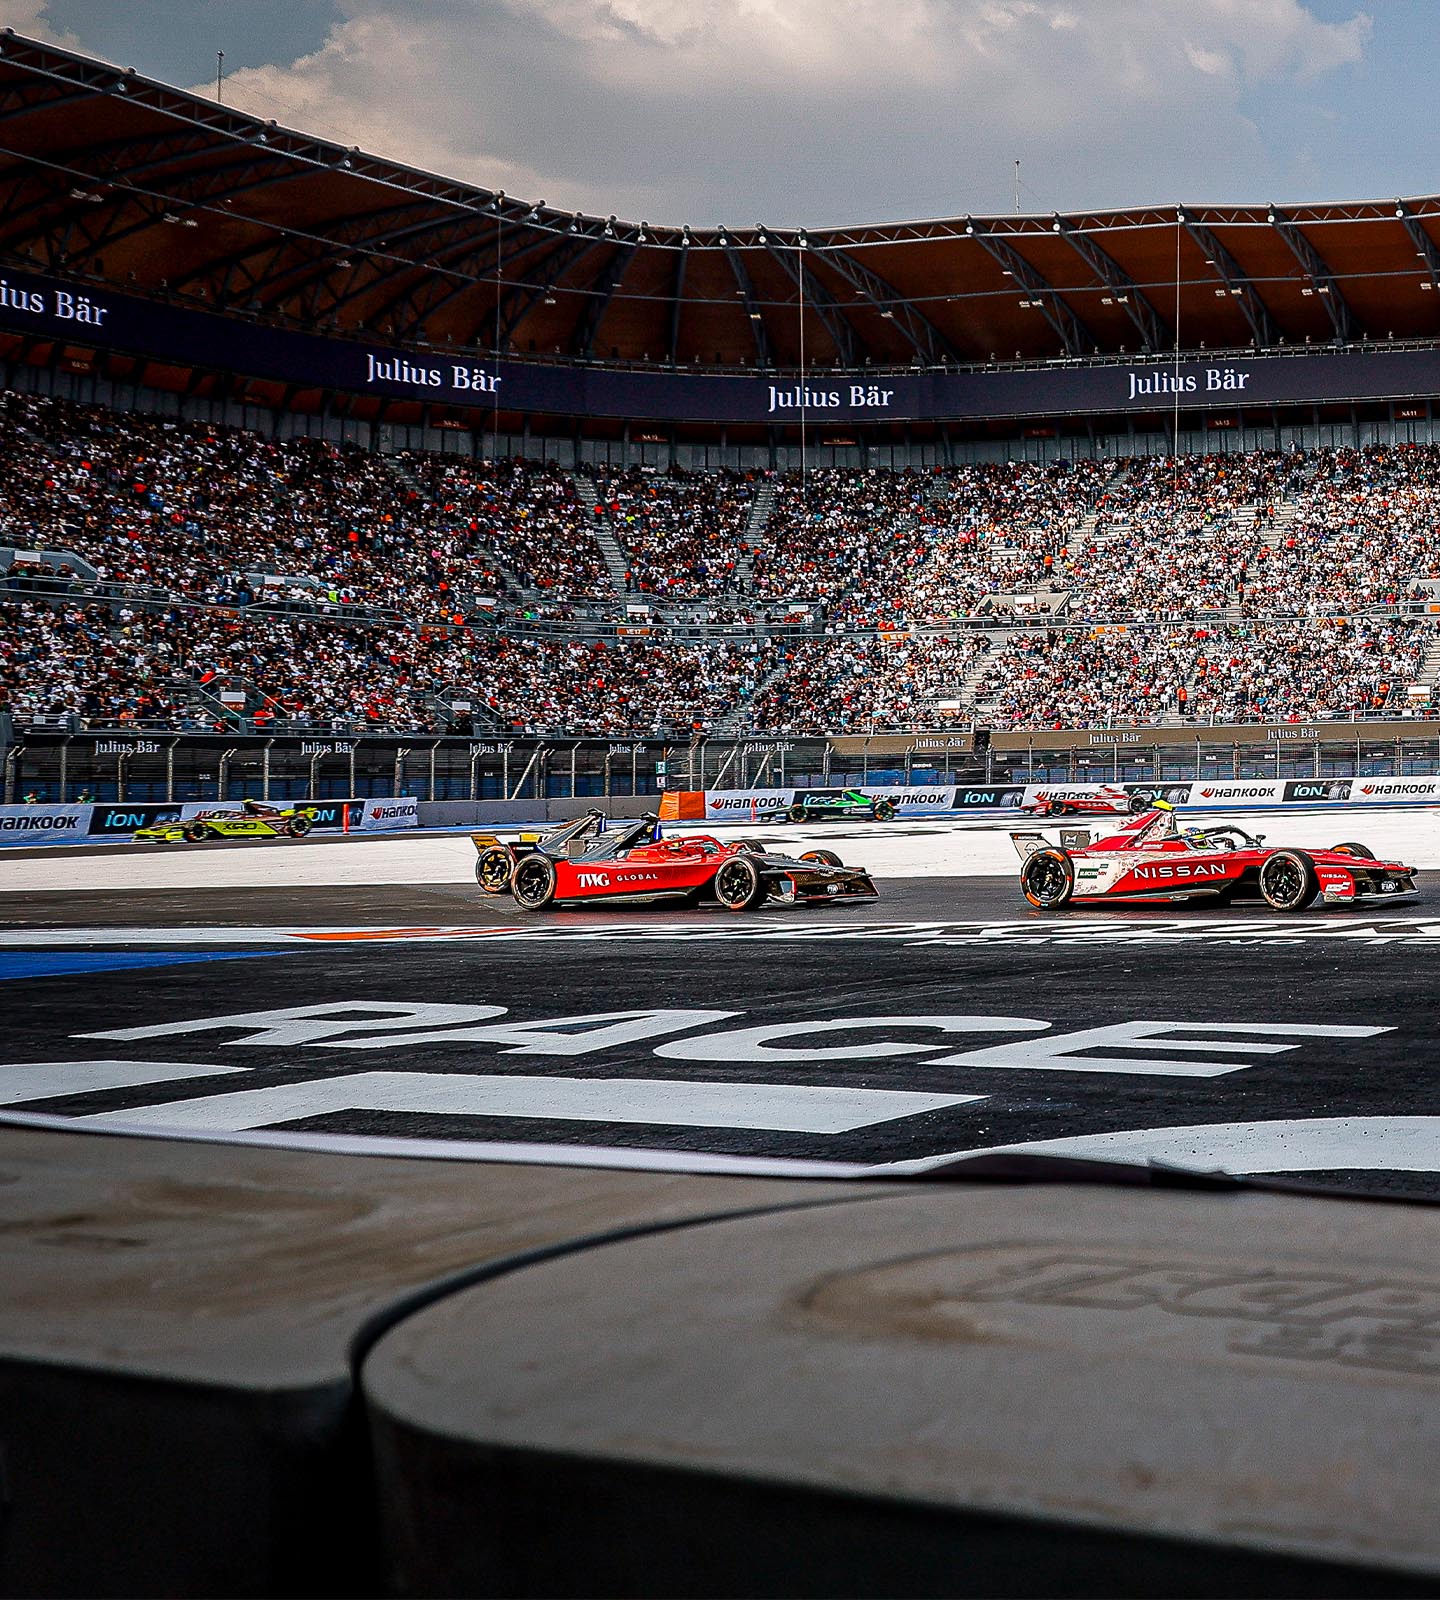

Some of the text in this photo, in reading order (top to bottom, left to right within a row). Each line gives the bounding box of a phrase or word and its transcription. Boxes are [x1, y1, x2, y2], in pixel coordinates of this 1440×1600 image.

[54, 290, 108, 326] Bär
[366, 353, 502, 392] Julius Bär
[1128, 369, 1249, 399] Julius Bär
[768, 386, 894, 412] Julius Bär
[1122, 732, 1141, 743] Bär
[1267, 728, 1320, 740] Julius Bär
[95, 740, 161, 756] Julius Bär
[301, 741, 332, 756] Julius
[915, 738, 944, 749] Julius
[889, 793, 946, 805] ANKOOK
[963, 791, 996, 804] iON
[1292, 785, 1323, 797] iON
[104, 810, 146, 827] iON
[310, 809, 336, 822] ON
[1133, 863, 1226, 879] NISSAN
[577, 872, 659, 888] TWG GLOBAL
[70, 1000, 1398, 1078] RACE
